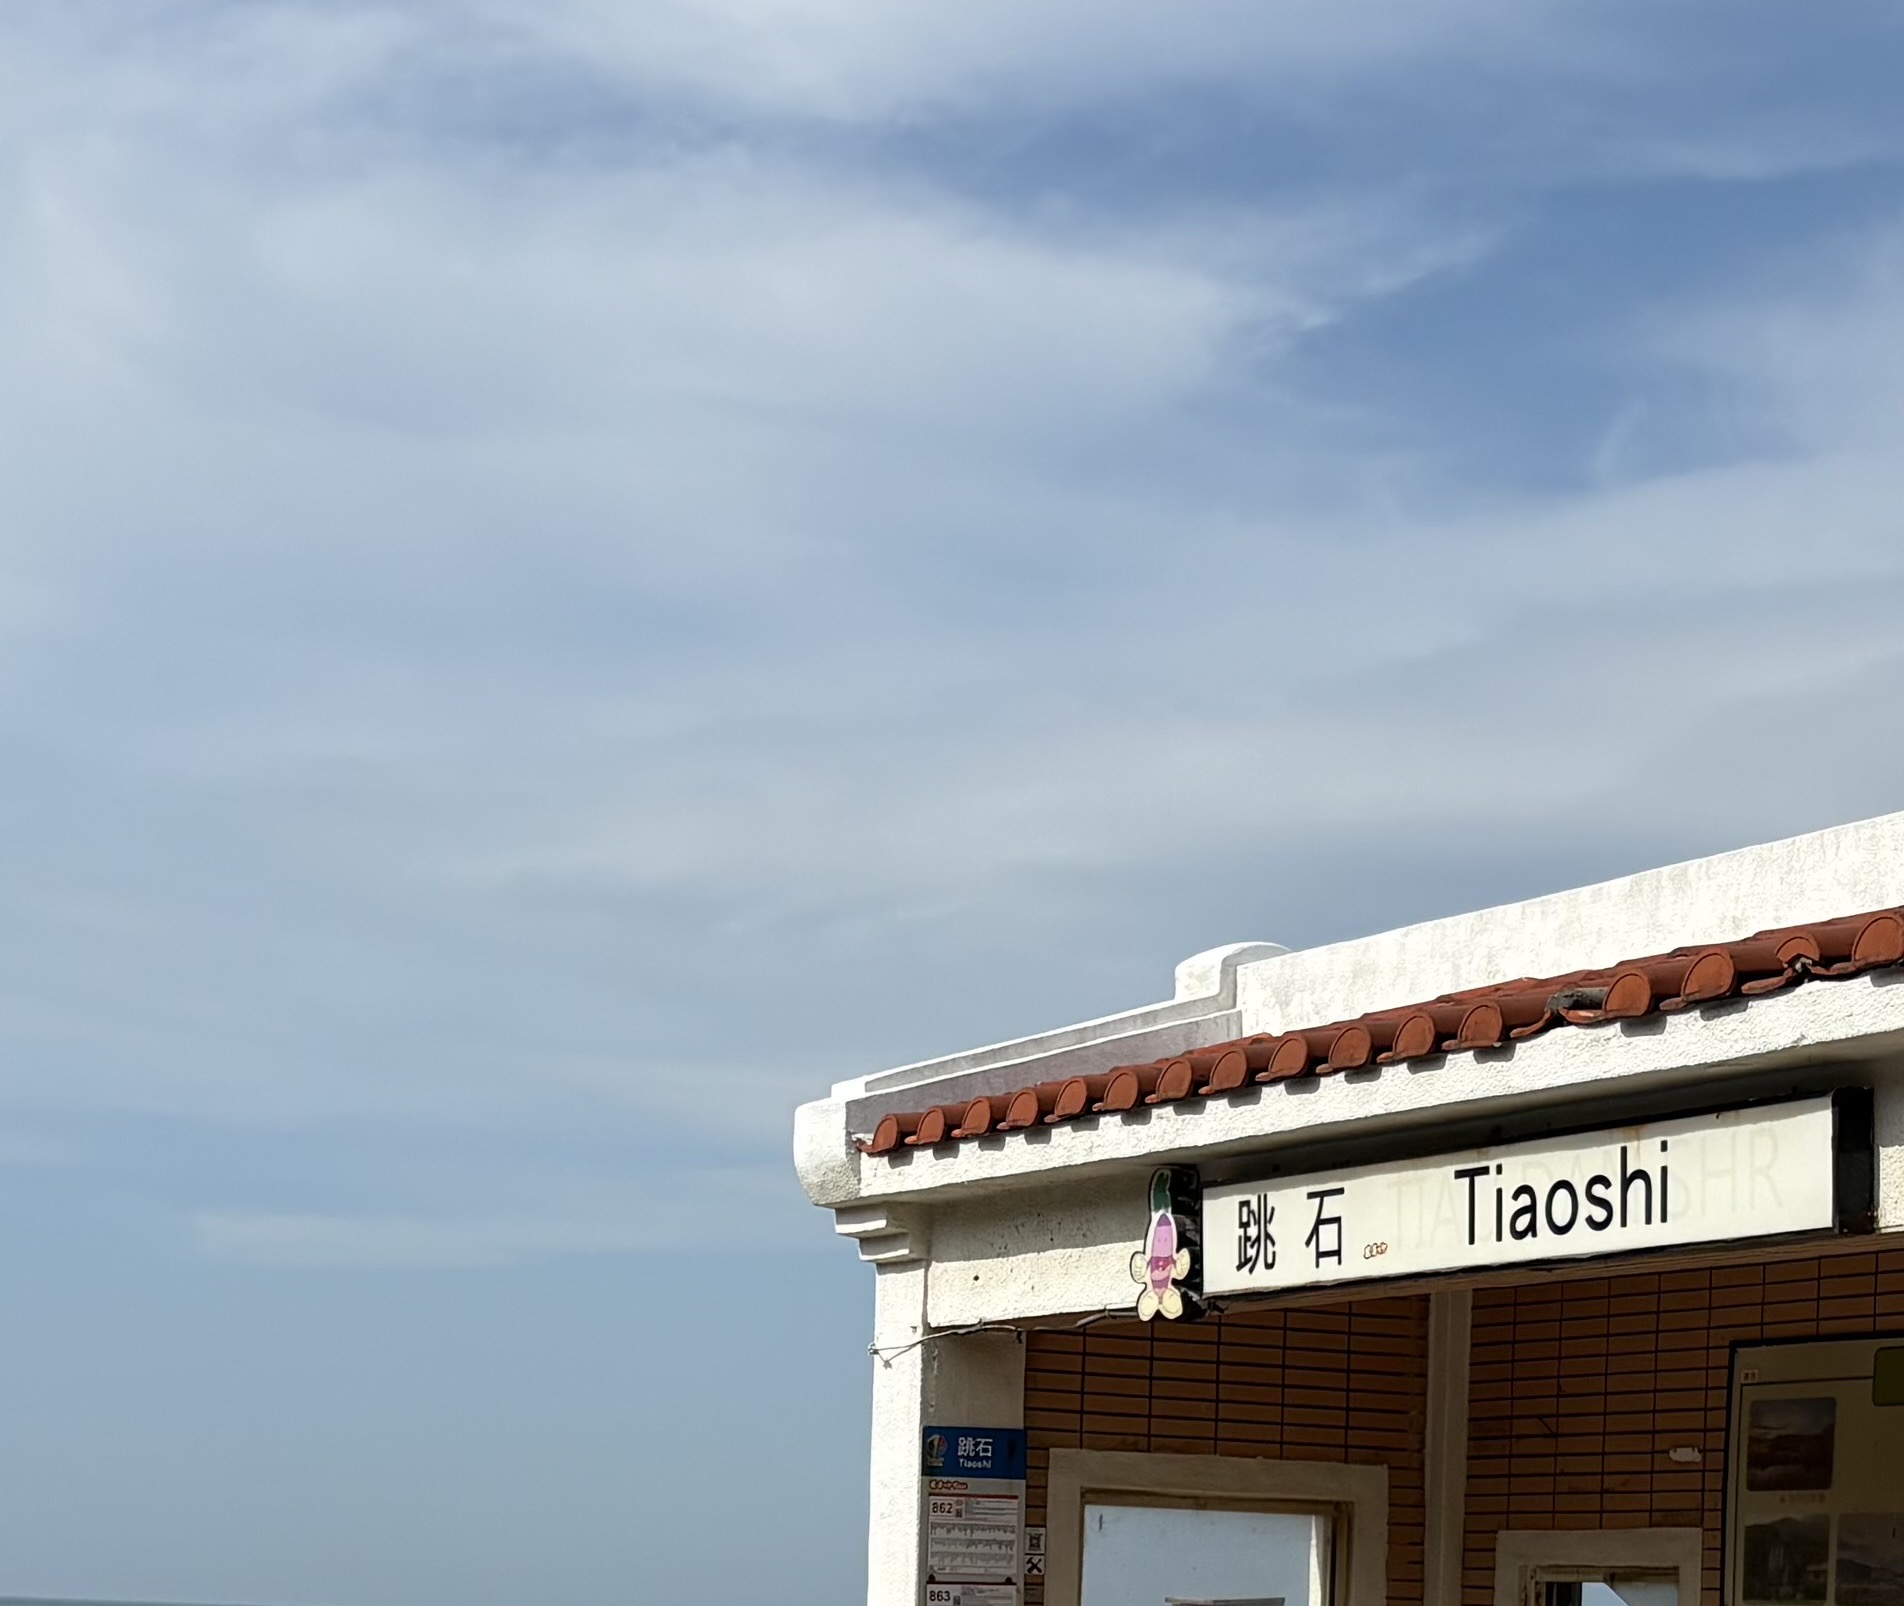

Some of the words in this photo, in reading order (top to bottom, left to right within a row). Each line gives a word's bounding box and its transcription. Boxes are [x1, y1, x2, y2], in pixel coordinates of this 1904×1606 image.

[1454, 1141, 1669, 1246] Tiaoshi
[1236, 1187, 1345, 1275] 跳石
[957, 1436, 994, 1457] 跳石
[958, 1458, 992, 1469] Tiaoshi
[931, 1502, 954, 1514] 862
[929, 1590, 952, 1602] 863
